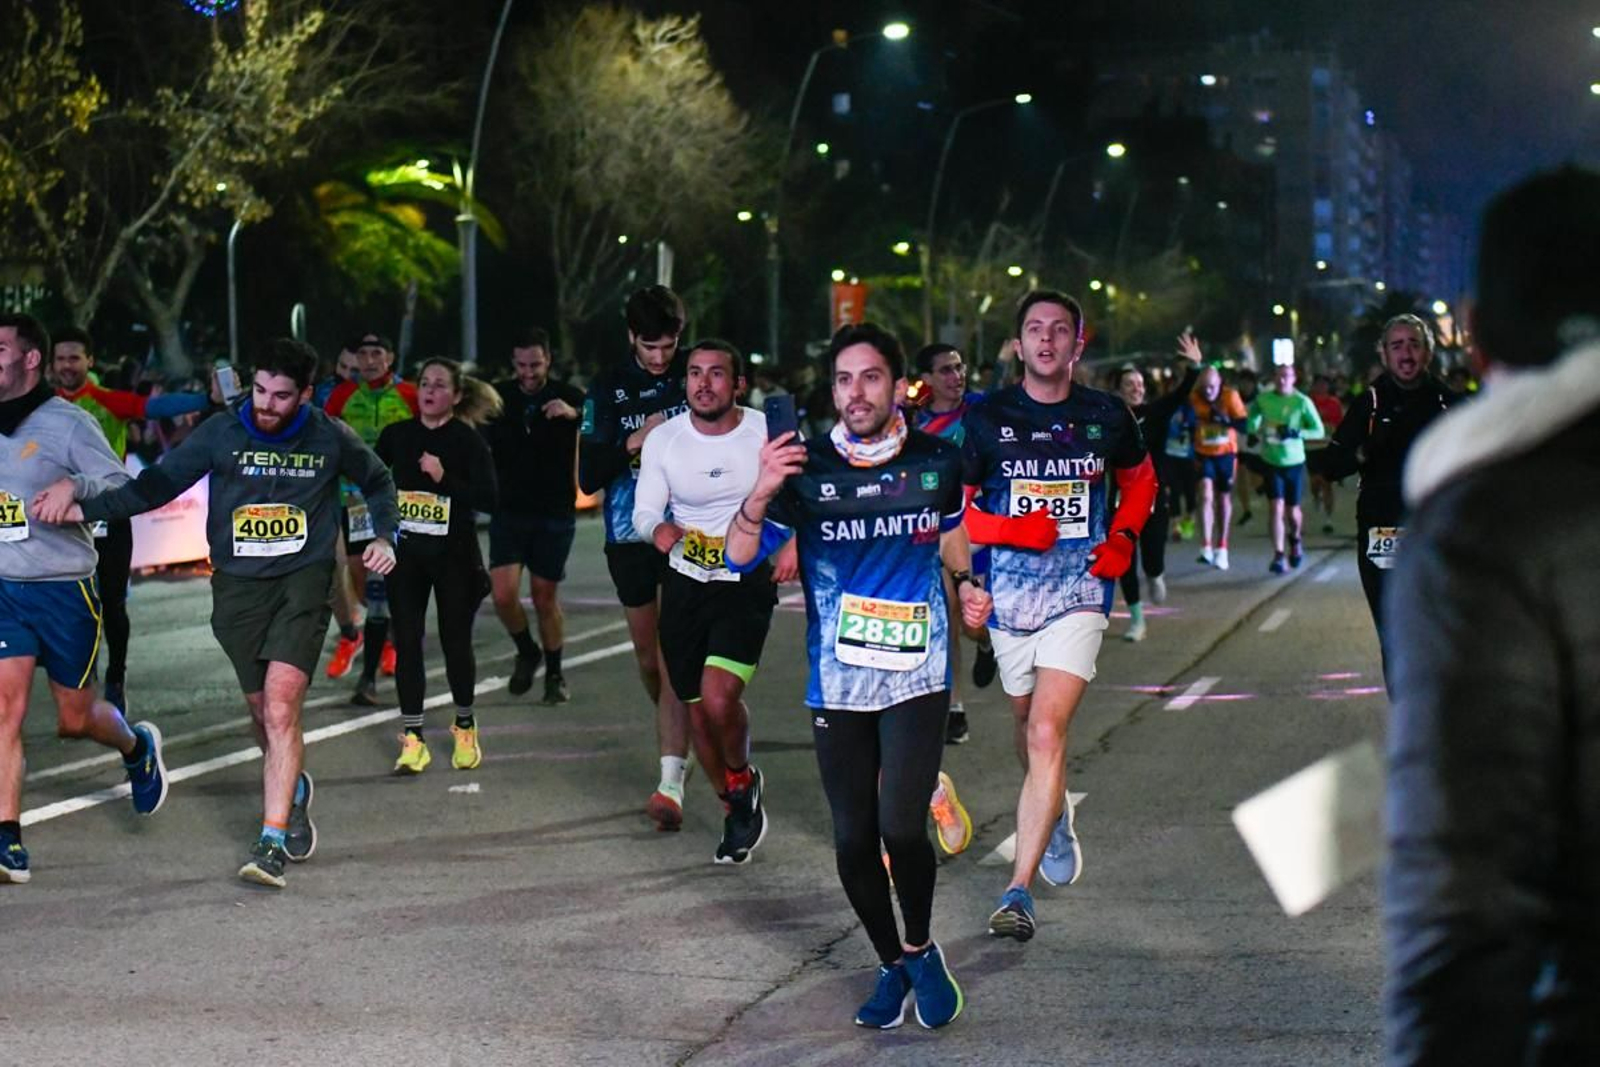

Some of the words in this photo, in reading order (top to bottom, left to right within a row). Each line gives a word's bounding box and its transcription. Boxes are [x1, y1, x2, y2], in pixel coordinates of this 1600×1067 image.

[620, 414, 646, 430] SAN
[1001, 459, 1038, 477] SAN
[1044, 453, 1105, 476] ANTÓN
[400, 502, 444, 520] 4068
[239, 518, 299, 537] 4000
[820, 518, 866, 541] SAN
[873, 507, 940, 538] ANTÓN
[687, 540, 726, 565] 343
[1372, 538, 1399, 552] 49
[843, 614, 923, 647] 2830
